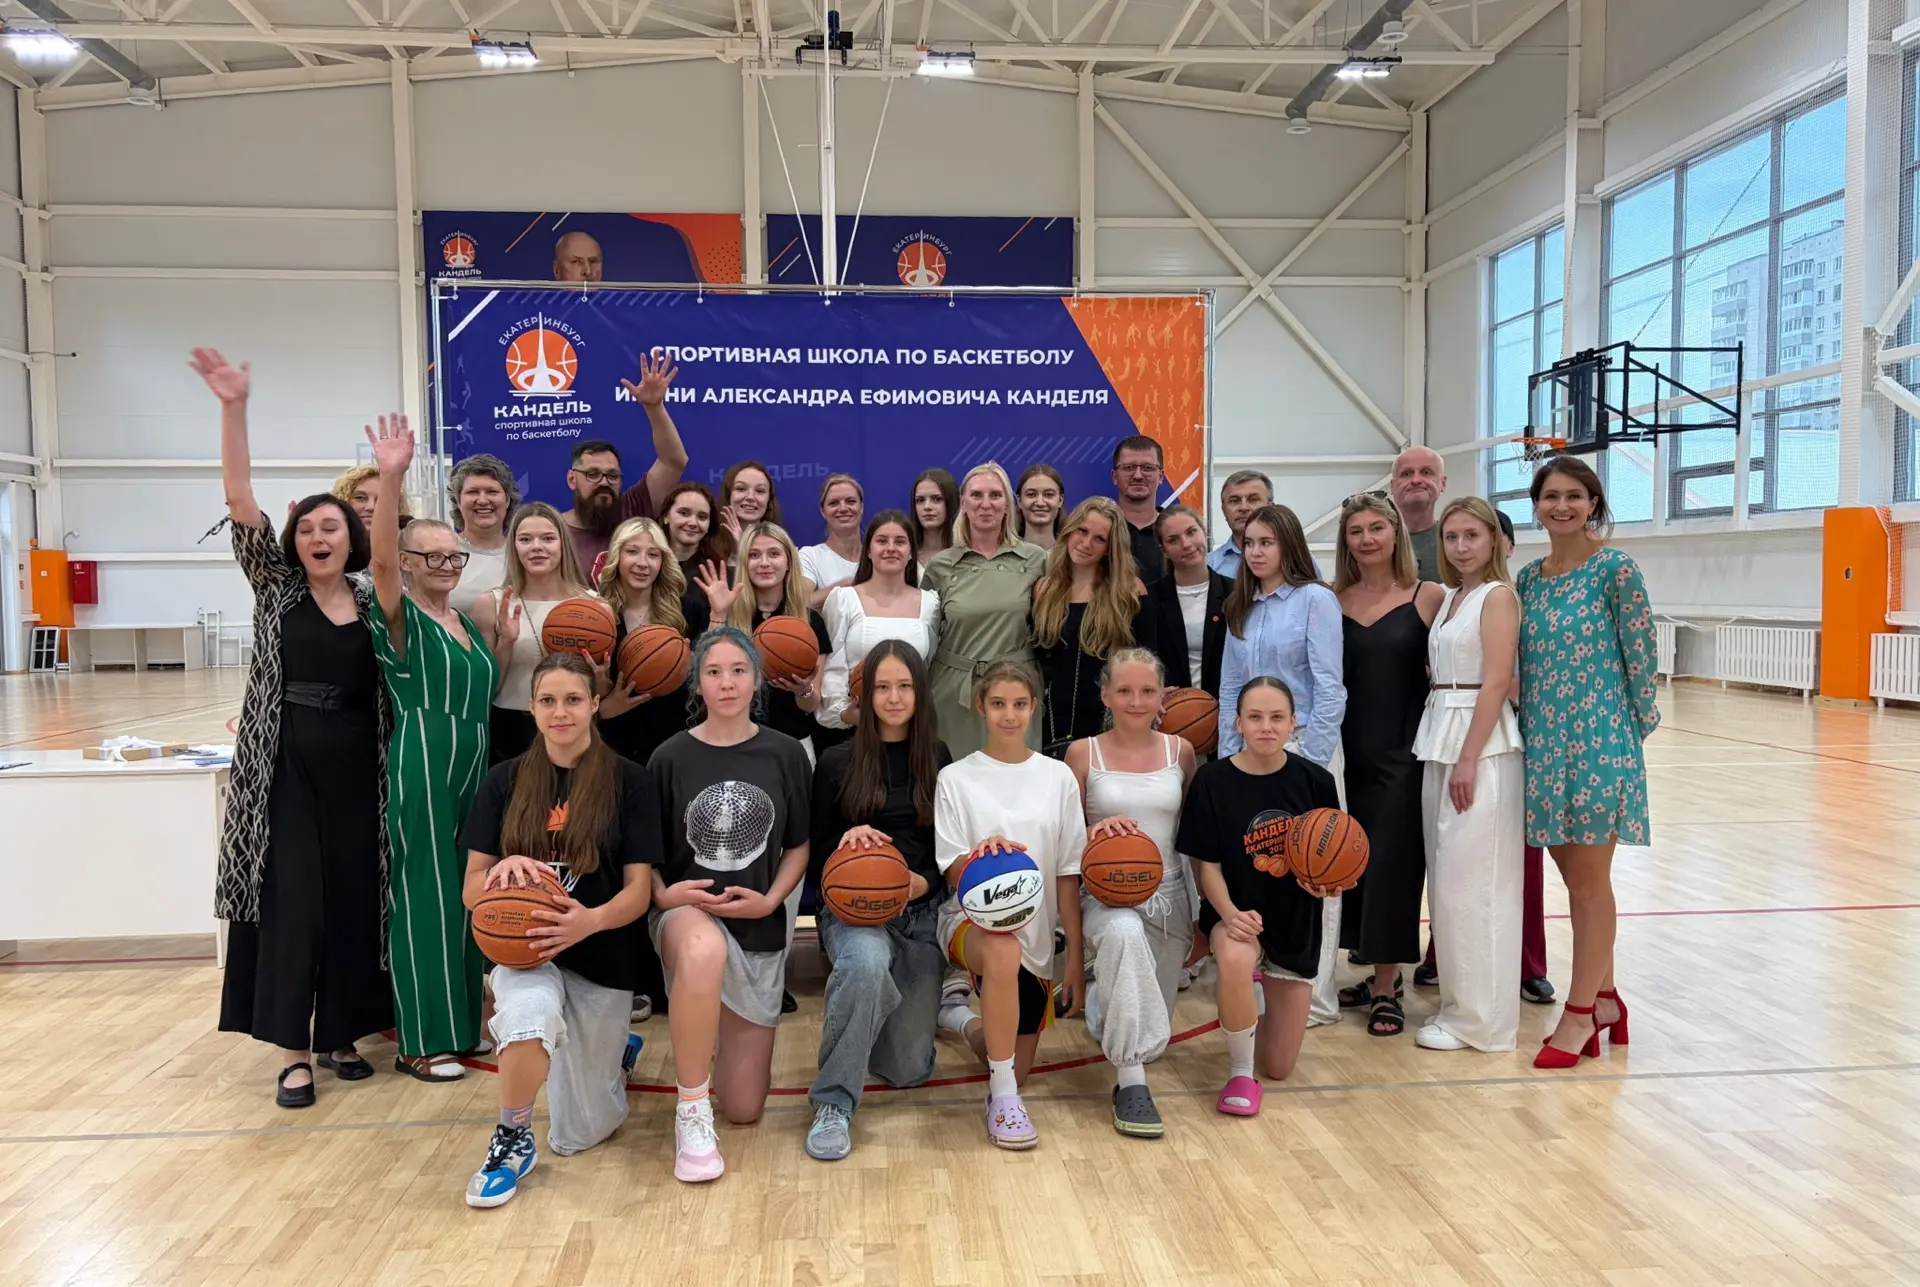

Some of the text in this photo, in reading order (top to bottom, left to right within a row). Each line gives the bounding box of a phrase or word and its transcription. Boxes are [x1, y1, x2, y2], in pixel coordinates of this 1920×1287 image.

[892, 232, 952, 255] ЕКАТЕРИНБУРГ
[438, 269, 482, 277] КАНДЕЛЬ
[498, 316, 586, 347] ЕКАТЕРИНБУРГ
[650, 346, 1075, 365] СПОРТИВНАЯ ШКОЛА ПО БАСКЕТБОЛУ
[615, 386, 1109, 408] ИНИ АЛЕКСАНДРА ЕФИМОВИЧА КАНДЕЛЯ
[493, 400, 592, 418] КАНДЕЛЬ
[494, 416, 593, 431] спортивная школа
[506, 427, 582, 441] по баскетболу
[708, 462, 830, 484] КДЕЛЬ
[1243, 817, 1293, 847] КАНДЕЛ
[1316, 812, 1339, 857] AMBITION
[1268, 844, 1284, 854] 202
[1101, 869, 1157, 883] JÖGEL
[842, 895, 901, 911] JÖGEL
